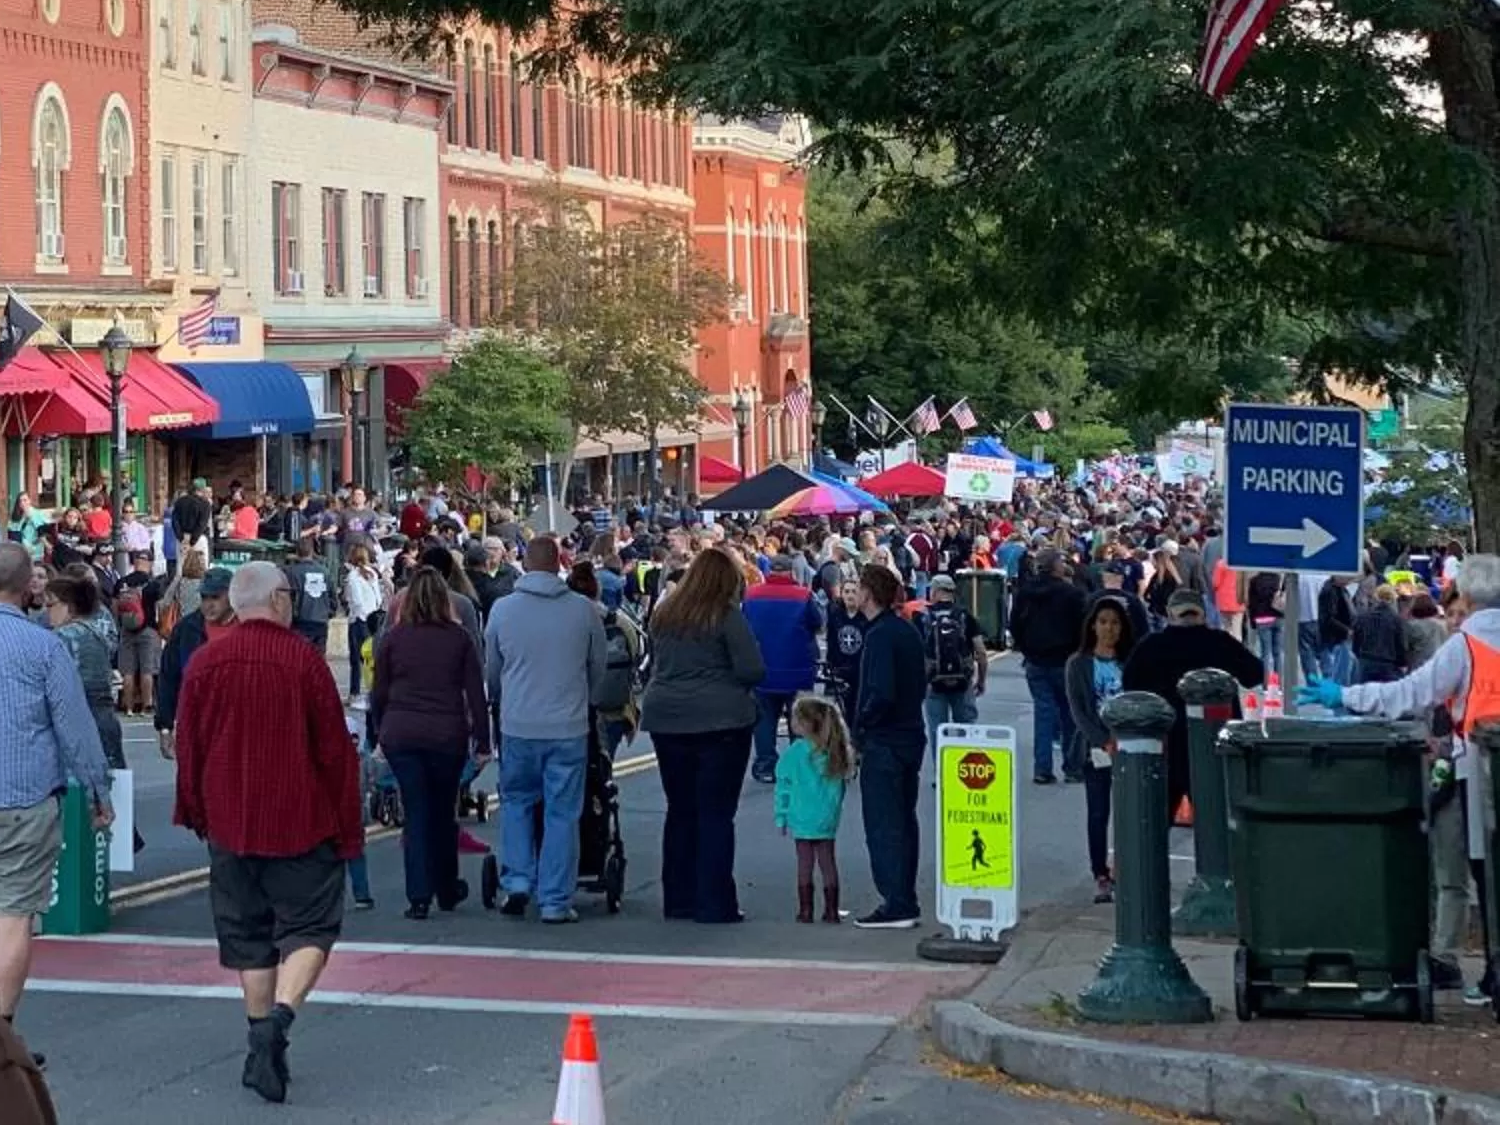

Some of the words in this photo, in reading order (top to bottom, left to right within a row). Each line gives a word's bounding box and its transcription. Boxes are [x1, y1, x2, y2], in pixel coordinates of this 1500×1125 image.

[1232, 418, 1357, 448] MUNICIPAL
[1242, 466, 1344, 496] PARKING
[959, 763, 995, 779] STOP
[967, 793, 988, 806] FOR
[948, 810, 1008, 825] PEDESTRIANS
